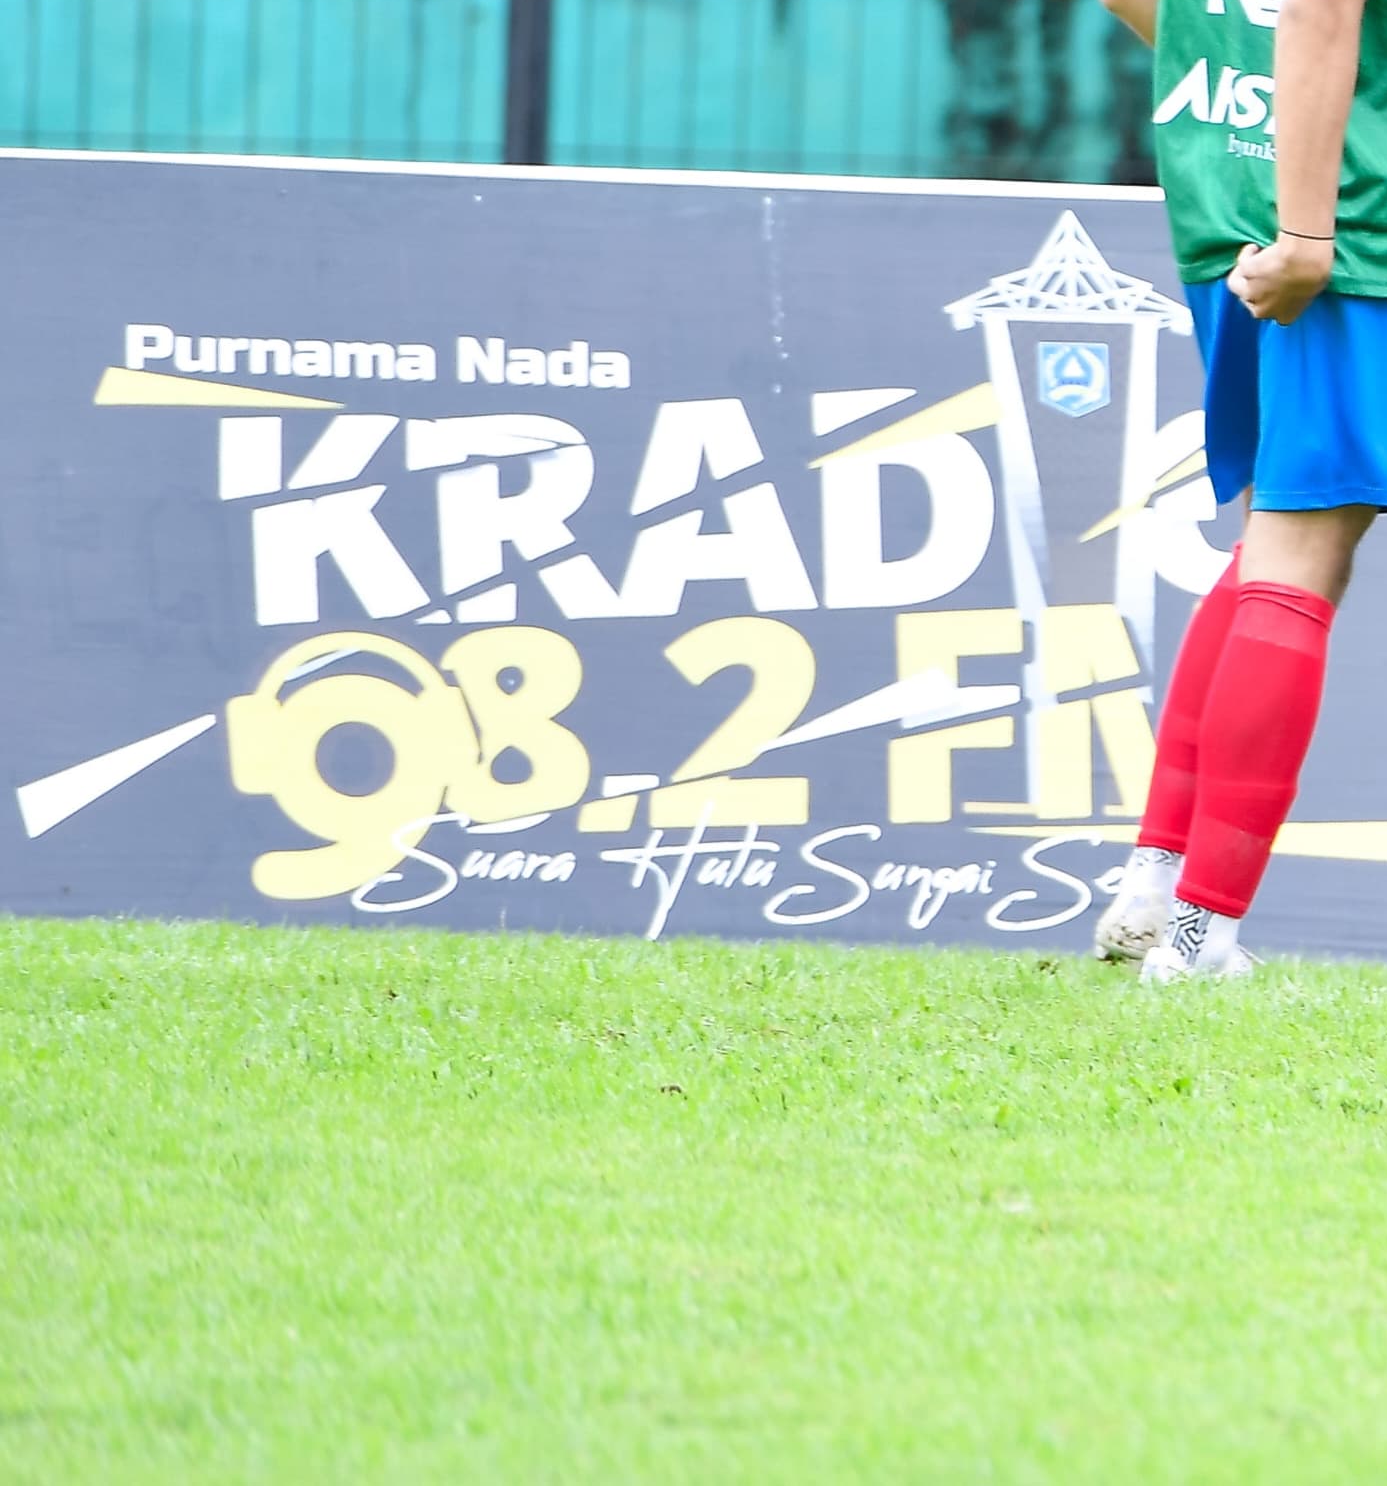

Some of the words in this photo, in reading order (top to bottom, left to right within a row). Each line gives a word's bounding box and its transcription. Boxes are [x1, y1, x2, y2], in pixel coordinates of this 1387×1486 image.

[124, 322, 437, 382] Purnama
[456, 335, 631, 390] Nada
[226, 615, 817, 901] 98.2
[352, 812, 576, 913] Suara
[600, 799, 781, 940] Hulu
[764, 824, 997, 930] Sungai
